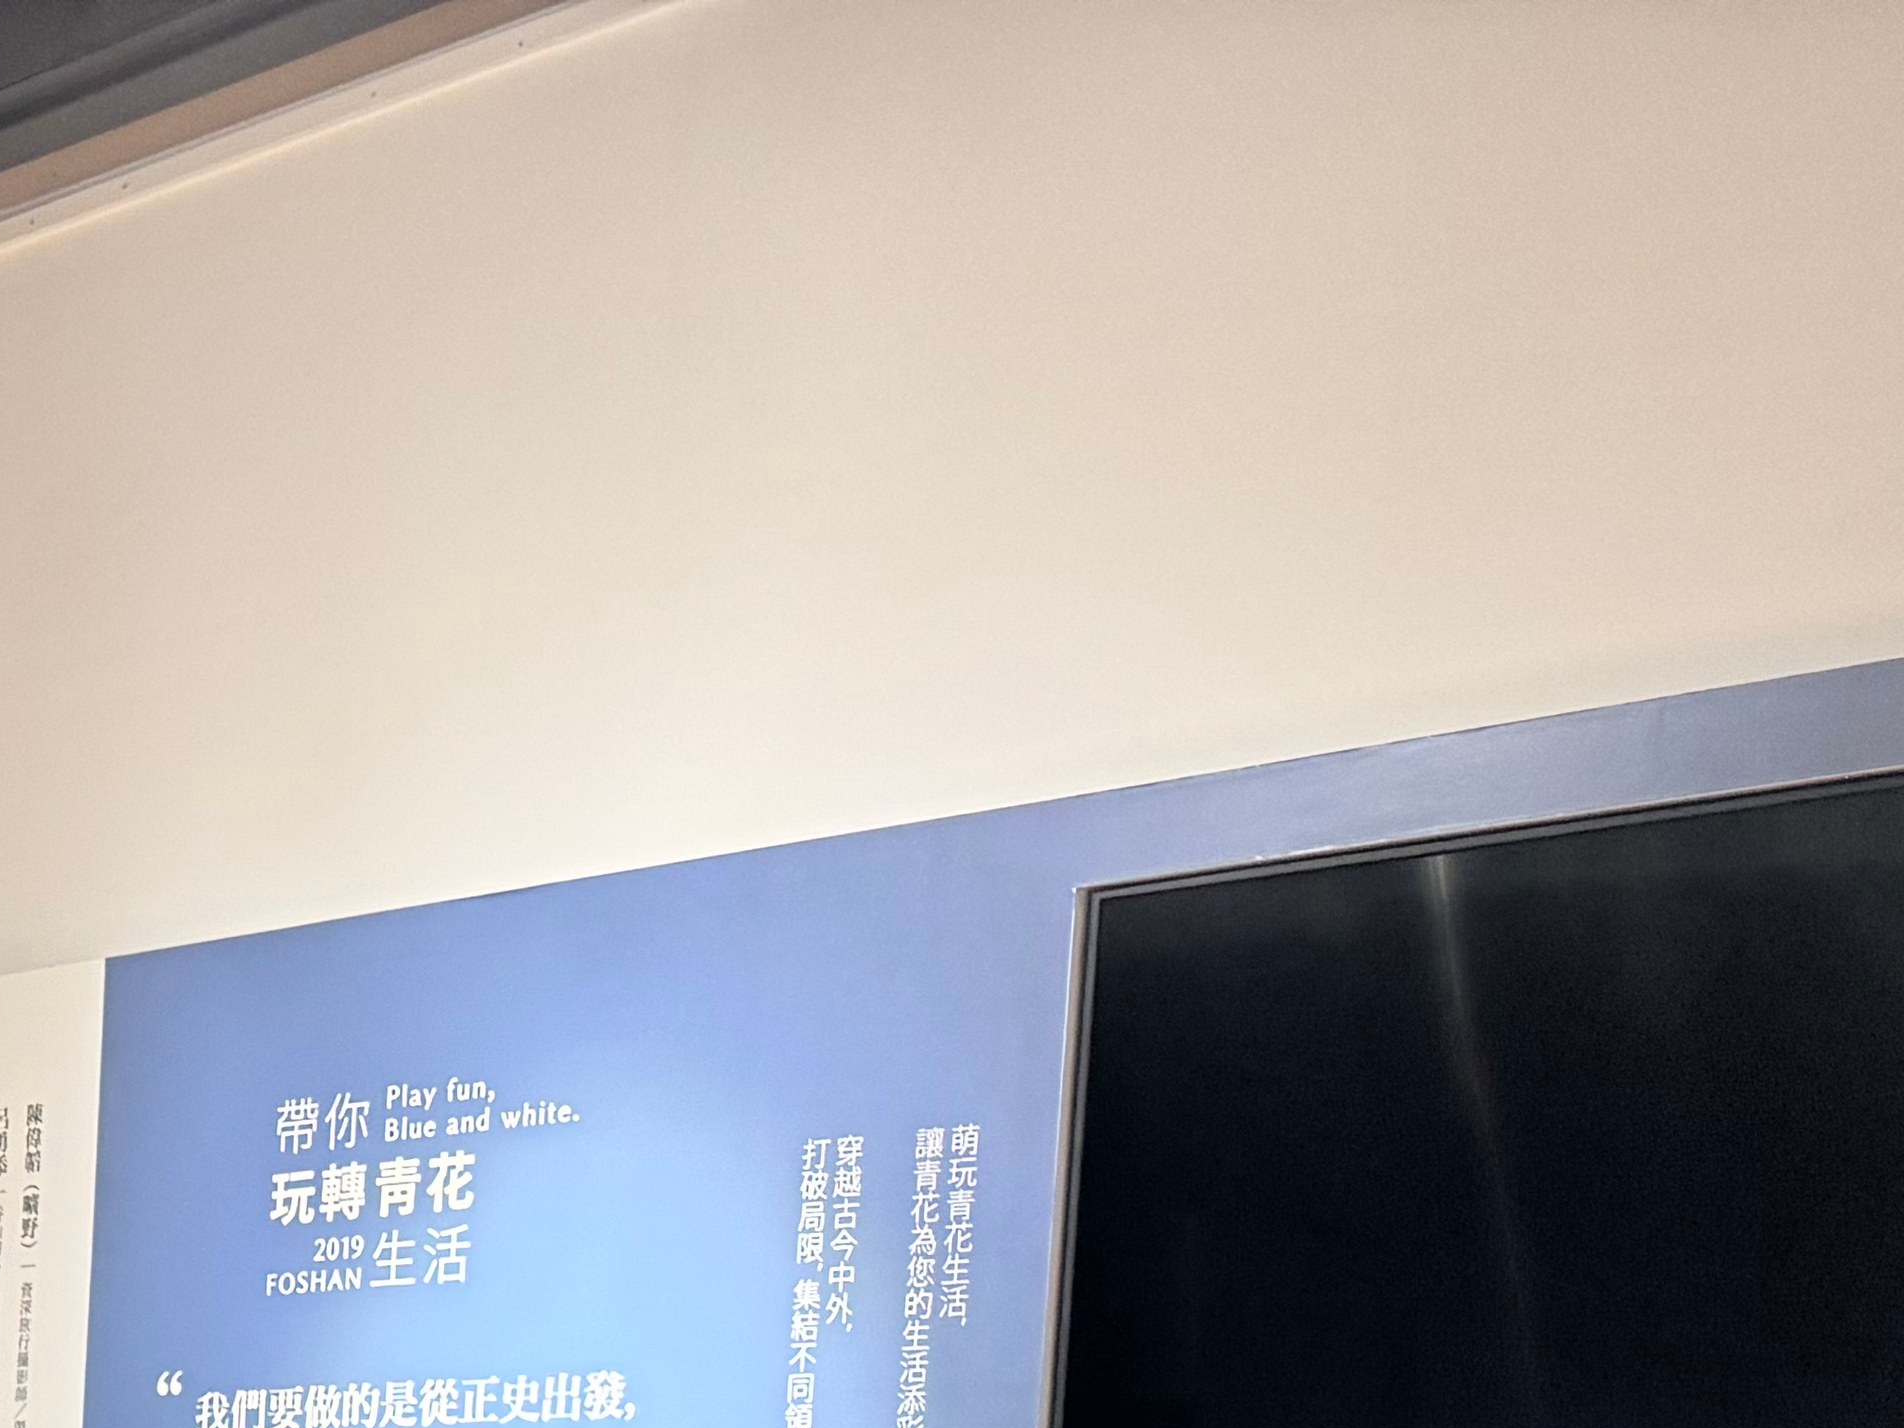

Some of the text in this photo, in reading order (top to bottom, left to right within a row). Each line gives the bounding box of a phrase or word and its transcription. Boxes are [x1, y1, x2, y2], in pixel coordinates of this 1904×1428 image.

[386, 1076, 496, 1111] Play fun,
[276, 1092, 370, 1155] 帶你
[384, 1101, 581, 1142] Blue and white.
[269, 1149, 476, 1226] 玩轉青花
[313, 1234, 365, 1262] 2019
[369, 1223, 472, 1288] 生活
[265, 1266, 363, 1297] FOSHAN
